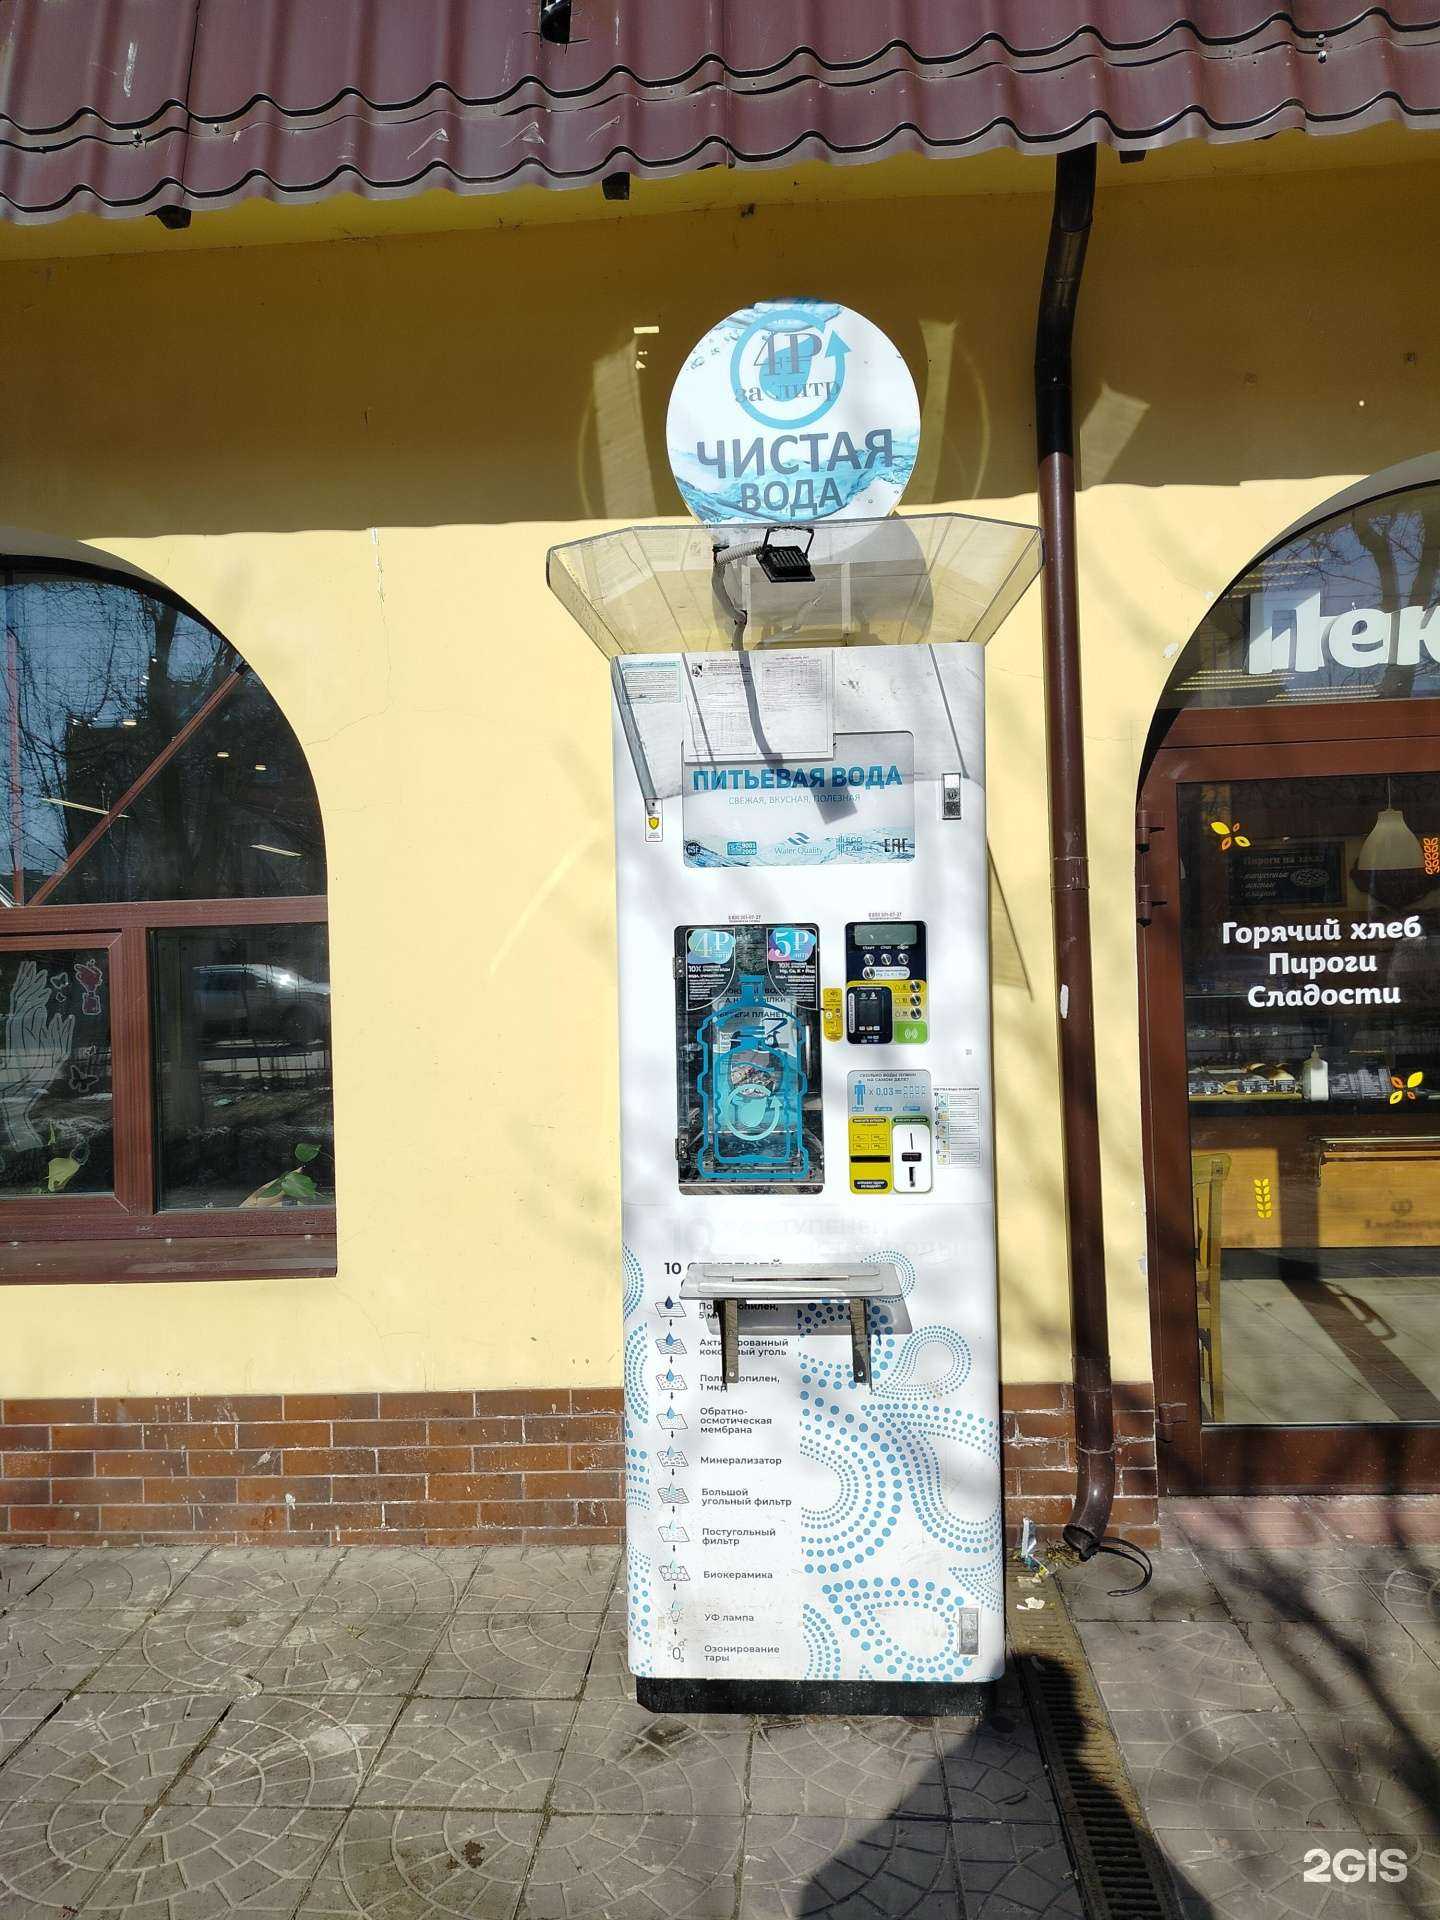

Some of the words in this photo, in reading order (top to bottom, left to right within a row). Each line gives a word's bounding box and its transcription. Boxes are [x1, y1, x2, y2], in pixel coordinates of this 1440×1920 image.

[696, 428, 894, 479] ЧИСТАЯ
[739, 477, 843, 517] ВОДА
[693, 767, 825, 792] ПИТЬЕВАЯ
[832, 765, 904, 789] ВОДА
[728, 796, 766, 806] СВЕЖАЯ,
[769, 794, 811, 806] ВКУСНАЯ,
[813, 793, 861, 804] ПОЛЕЗНАЯ
[798, 847, 823, 856] Quality
[1222, 919, 1341, 949] Горячий
[1350, 915, 1422, 940] хлеб
[1269, 952, 1378, 979] Пироги
[1247, 984, 1402, 1008] Сладости
[664, 1262, 682, 1275] 10
[699, 1302, 779, 1312] Поопилен,
[700, 1338, 789, 1347] Актированный
[757, 1349, 787, 1357] уголь
[700, 1374, 780, 1383] Полопилен,
[700, 1407, 748, 1416] Обратно-
[700, 1426, 752, 1435] мембрана
[700, 1456, 782, 1466] Минерализатор
[701, 1488, 749, 1496] Большой
[701, 1497, 751, 1506] угольный
[754, 1497, 792, 1507] фильтр
[702, 1528, 776, 1537] Постугольный
[702, 1537, 740, 1546] фильтр
[703, 1570, 773, 1580] Биокерамика
[704, 1613, 720, 1621] УФ
[704, 1644, 780, 1653] Озонирование
[704, 1655, 729, 1663] тары
